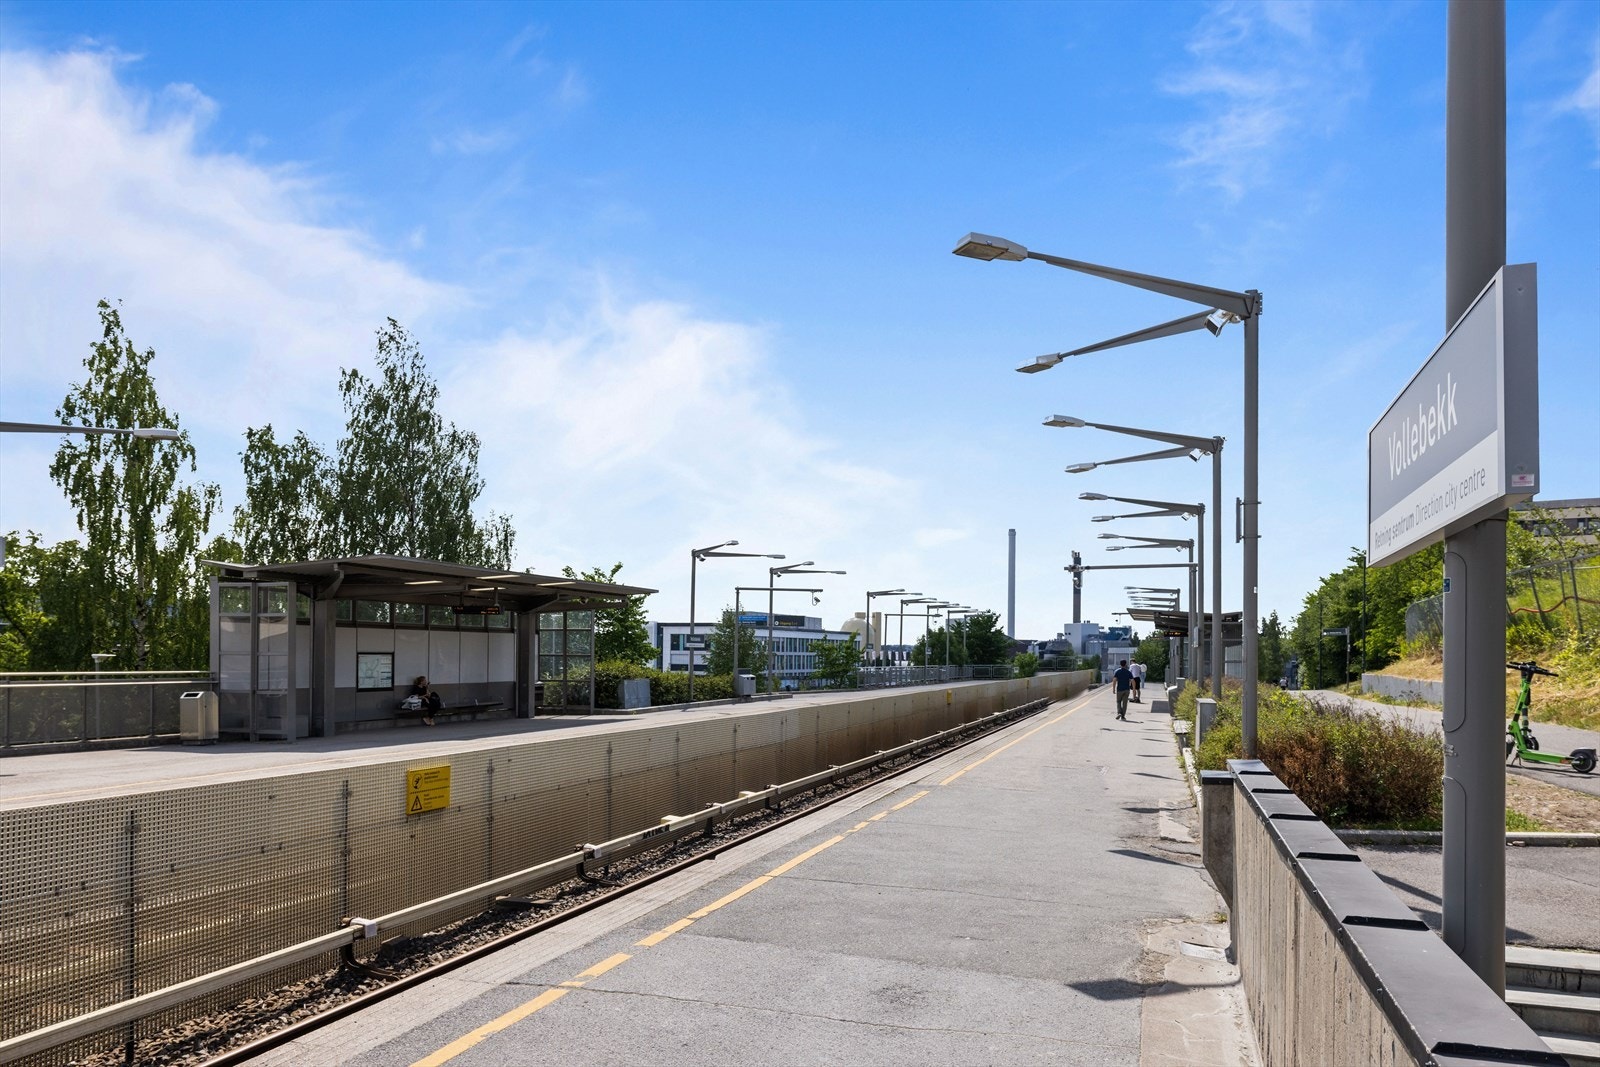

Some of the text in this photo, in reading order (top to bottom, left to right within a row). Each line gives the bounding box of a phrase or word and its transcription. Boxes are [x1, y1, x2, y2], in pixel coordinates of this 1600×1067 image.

[1388, 372, 1458, 481] Vollebekk
[1392, 510, 1415, 539] sentrum
[1416, 494, 1444, 526] Direction
[1444, 482, 1458, 510] city
[1459, 468, 1486, 499] centre
